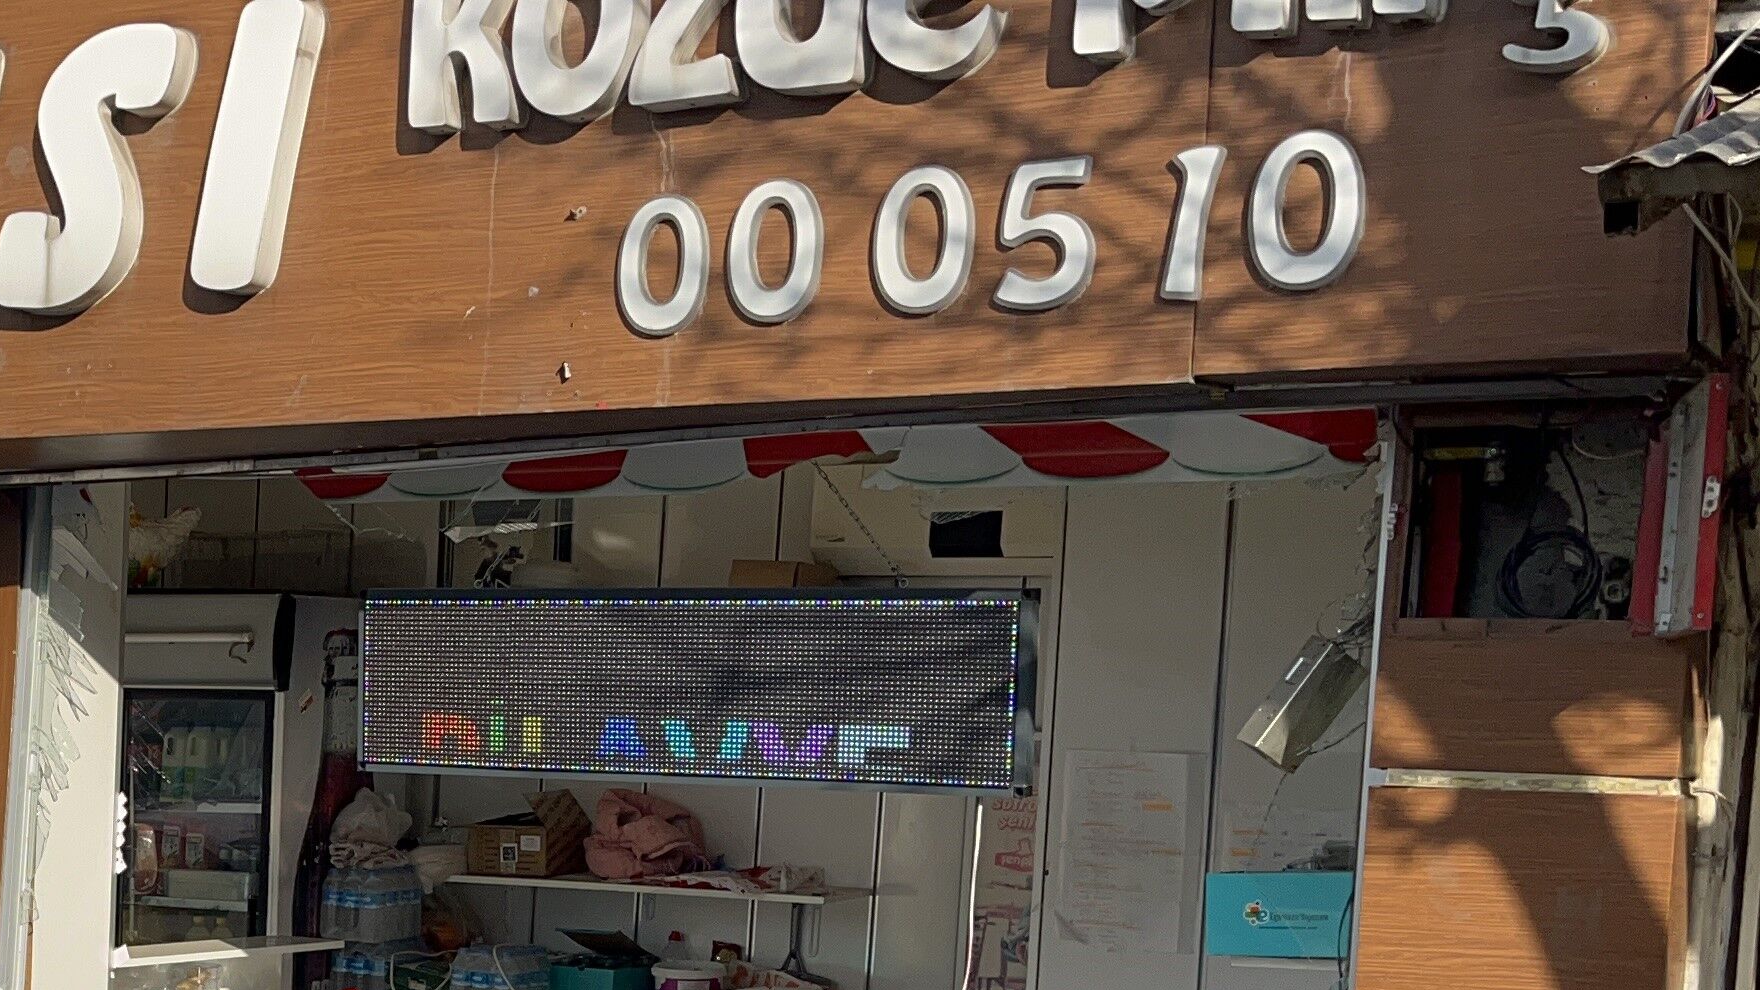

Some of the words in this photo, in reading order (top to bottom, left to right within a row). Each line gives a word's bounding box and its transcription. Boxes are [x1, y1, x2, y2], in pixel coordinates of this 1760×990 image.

[615, 177, 825, 338] 00
[870, 155, 1098, 317] 05
[1158, 130, 1368, 304] 10
